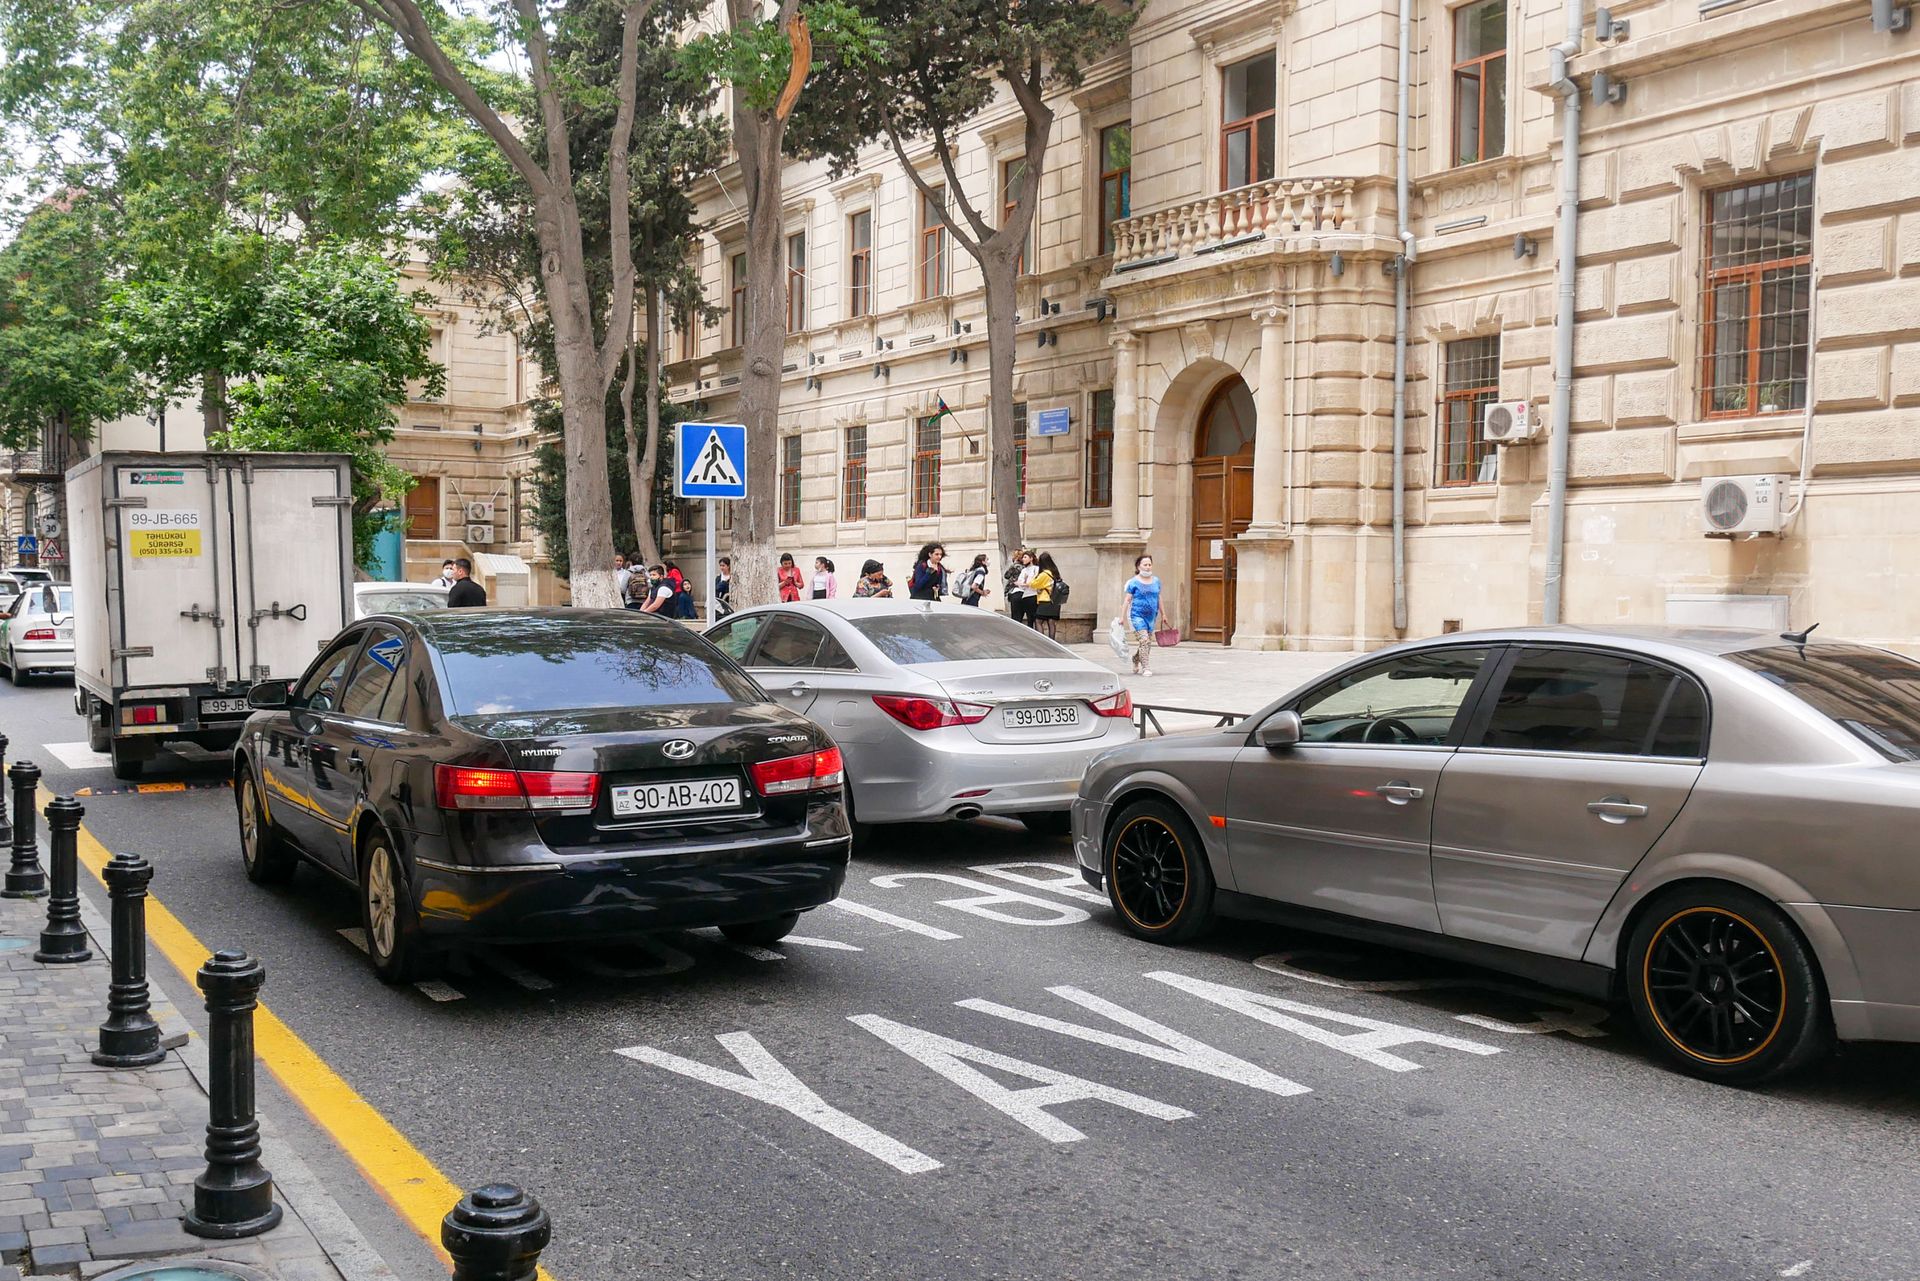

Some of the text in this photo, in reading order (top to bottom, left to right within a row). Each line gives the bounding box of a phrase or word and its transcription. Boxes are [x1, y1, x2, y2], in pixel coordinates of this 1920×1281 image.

[131, 513, 198, 525] 99-JB-665
[46, 524, 57, 533] 30
[212, 699, 253, 712] 99-JB-
[767, 734, 809, 745] SONATA
[520, 748, 562, 758] HYUNDAI
[617, 782, 736, 811] AZ 90-AB-402
